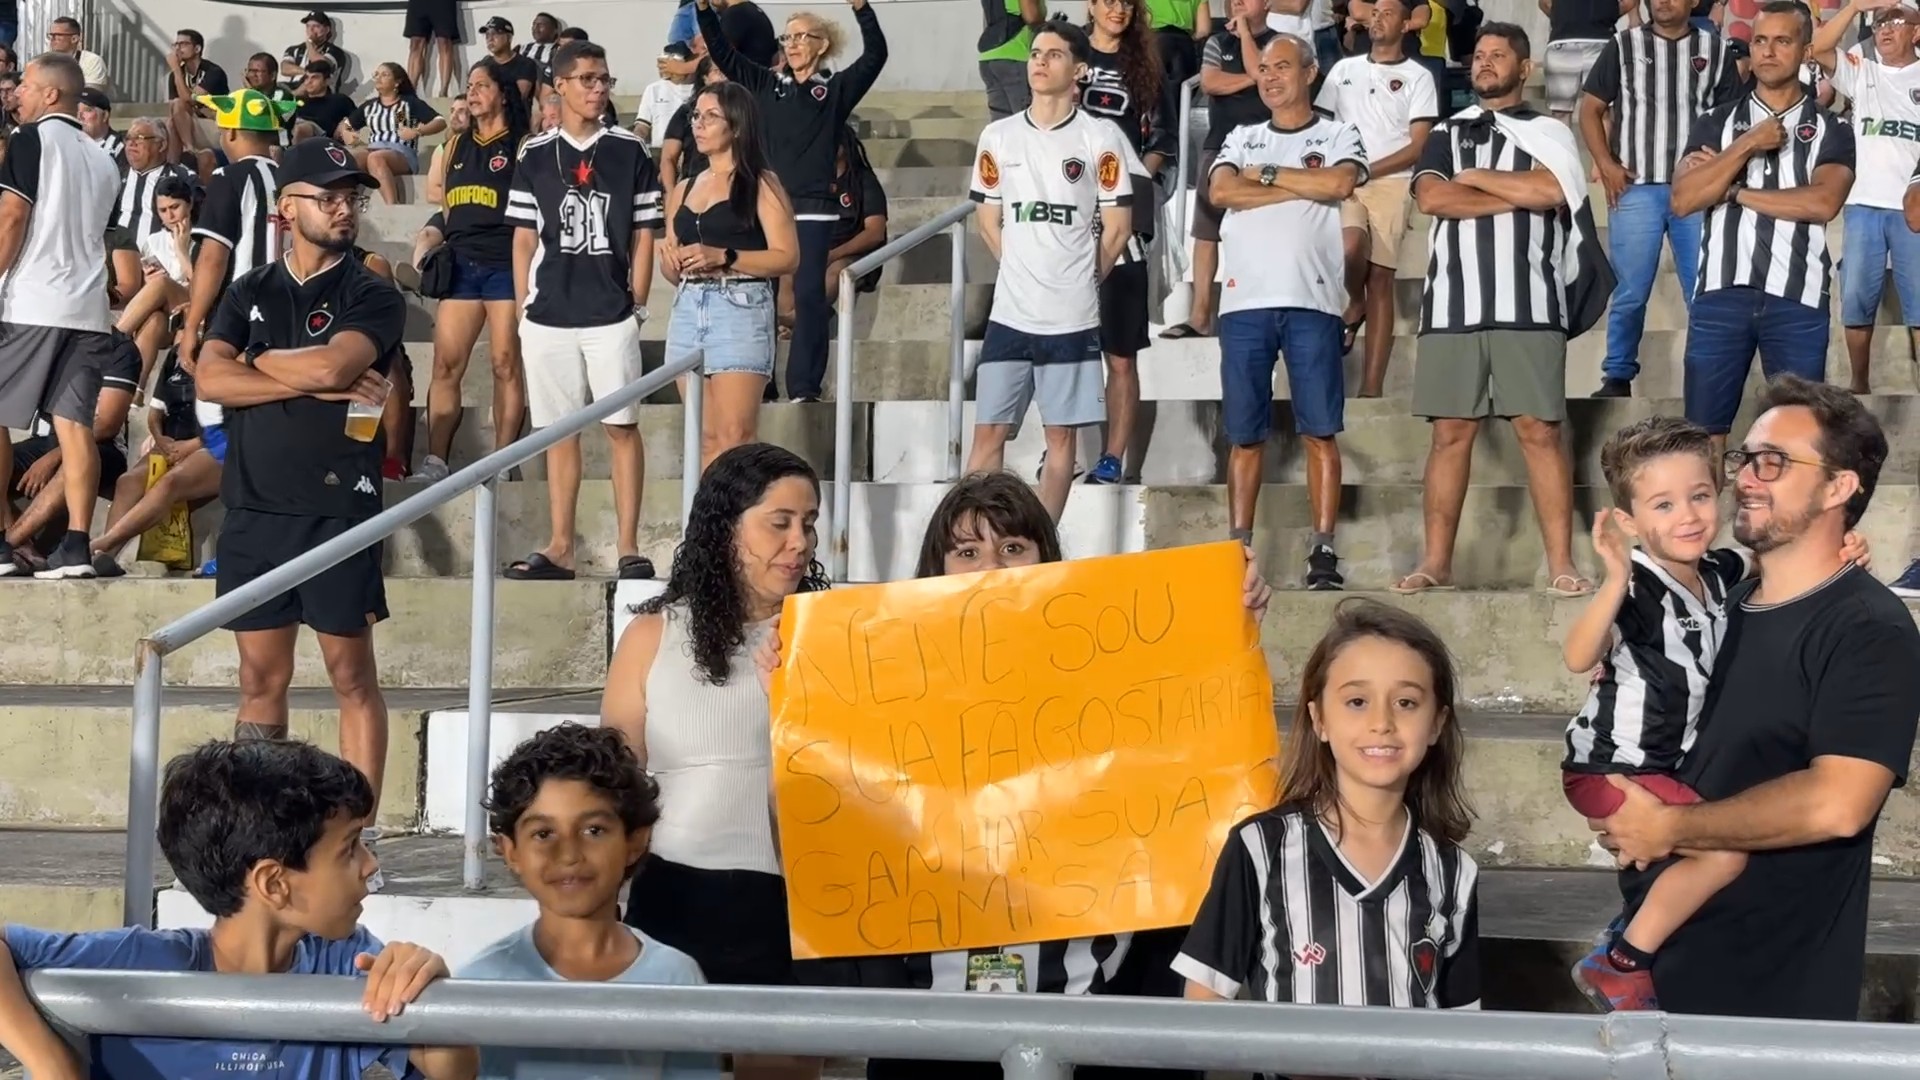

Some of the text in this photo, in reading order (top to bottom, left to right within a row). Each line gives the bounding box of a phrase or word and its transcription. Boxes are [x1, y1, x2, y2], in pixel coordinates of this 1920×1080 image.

[447, 185, 497, 208] OTAFOGO
[559, 189, 612, 255] 31
[1043, 582, 1174, 671] SOU
[787, 721, 948, 825] SUA
[791, 777, 1210, 917] GANHAR SUA
[215, 1062, 264, 1071] ILLINOI
[232, 1052, 266, 1060] CHICA
